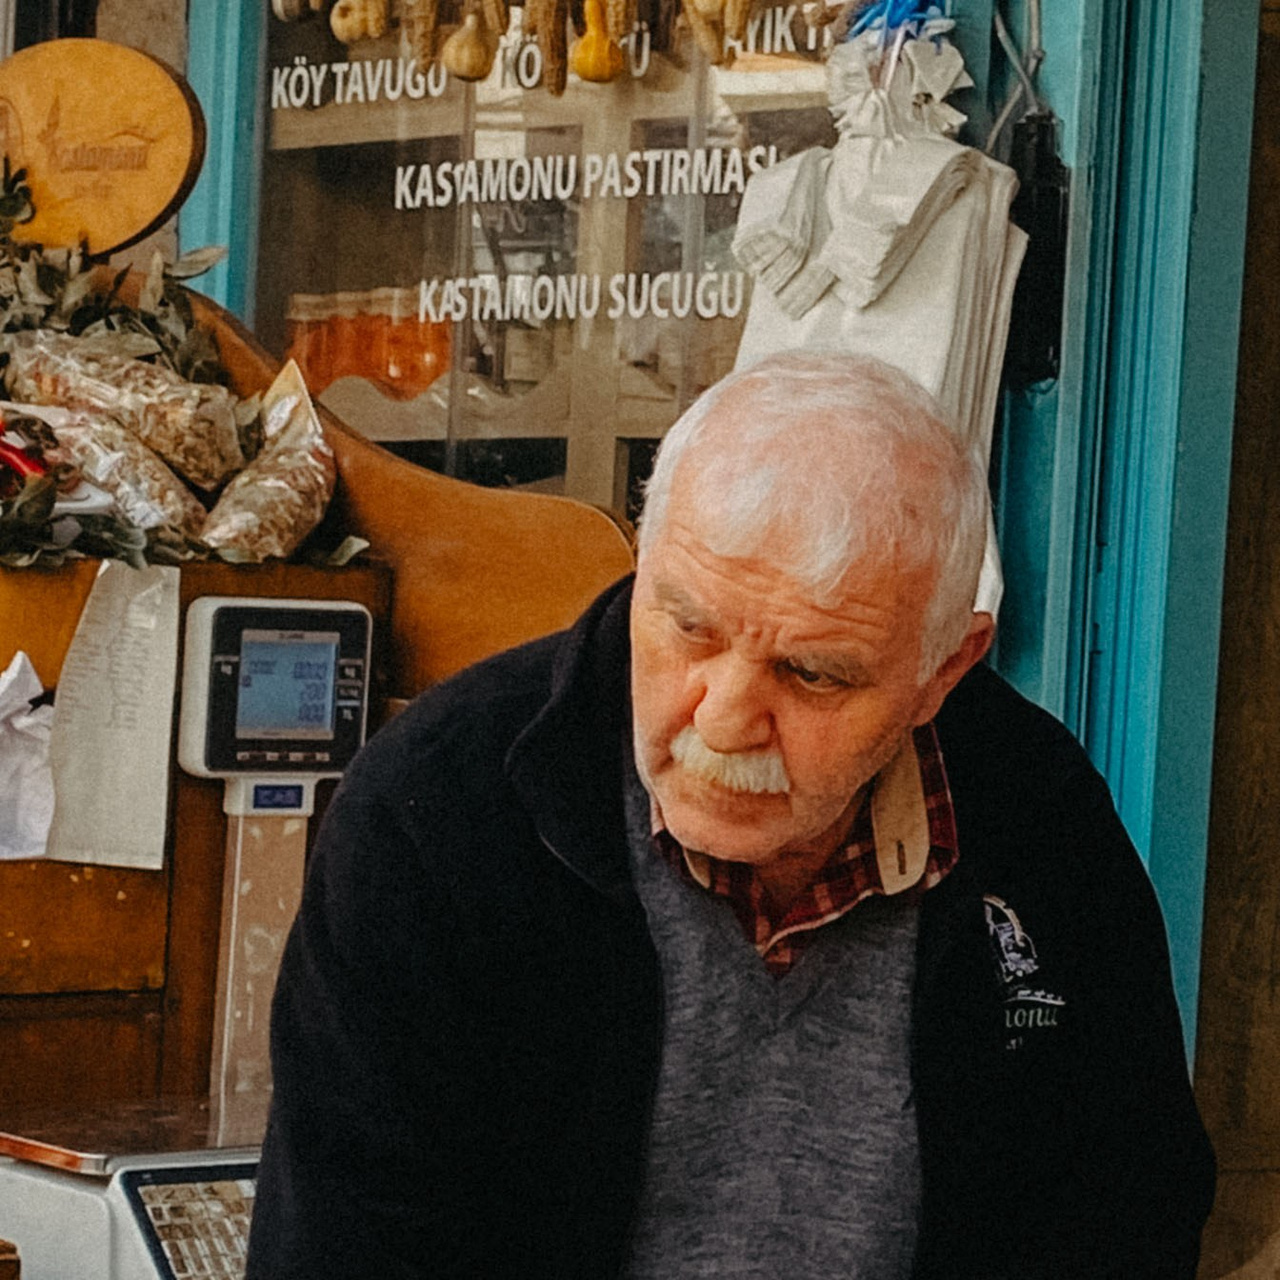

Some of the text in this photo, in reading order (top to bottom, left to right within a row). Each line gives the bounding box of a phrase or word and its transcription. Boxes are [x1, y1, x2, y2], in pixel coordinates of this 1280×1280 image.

[271, 55, 328, 109] KÖY
[394, 155, 577, 210] KASTAMONU
[418, 261, 744, 324] KASTAMONU SUCUĞU
